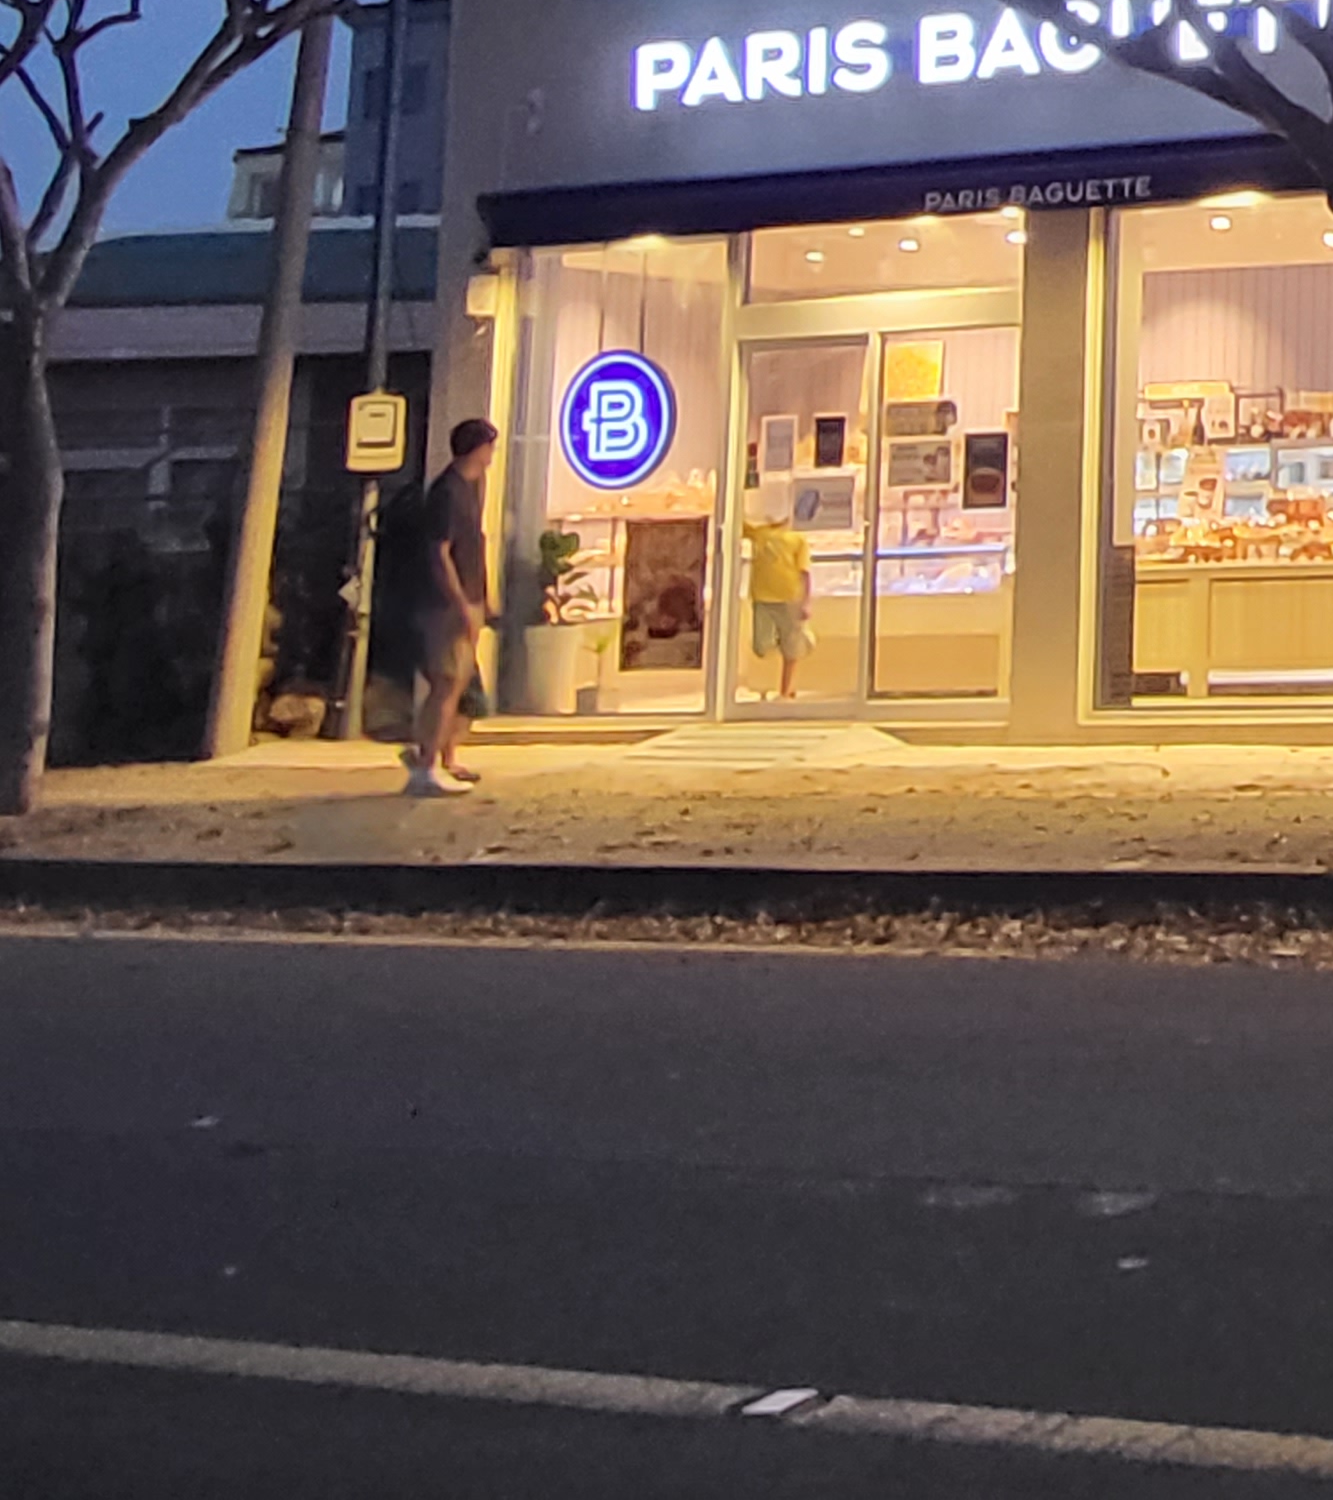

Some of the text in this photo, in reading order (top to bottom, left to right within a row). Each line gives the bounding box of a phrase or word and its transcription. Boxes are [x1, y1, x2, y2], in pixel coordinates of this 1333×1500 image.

[634, 19, 891, 111] PARIS
[924, 175, 1151, 212] PARIS BAGUETTE
